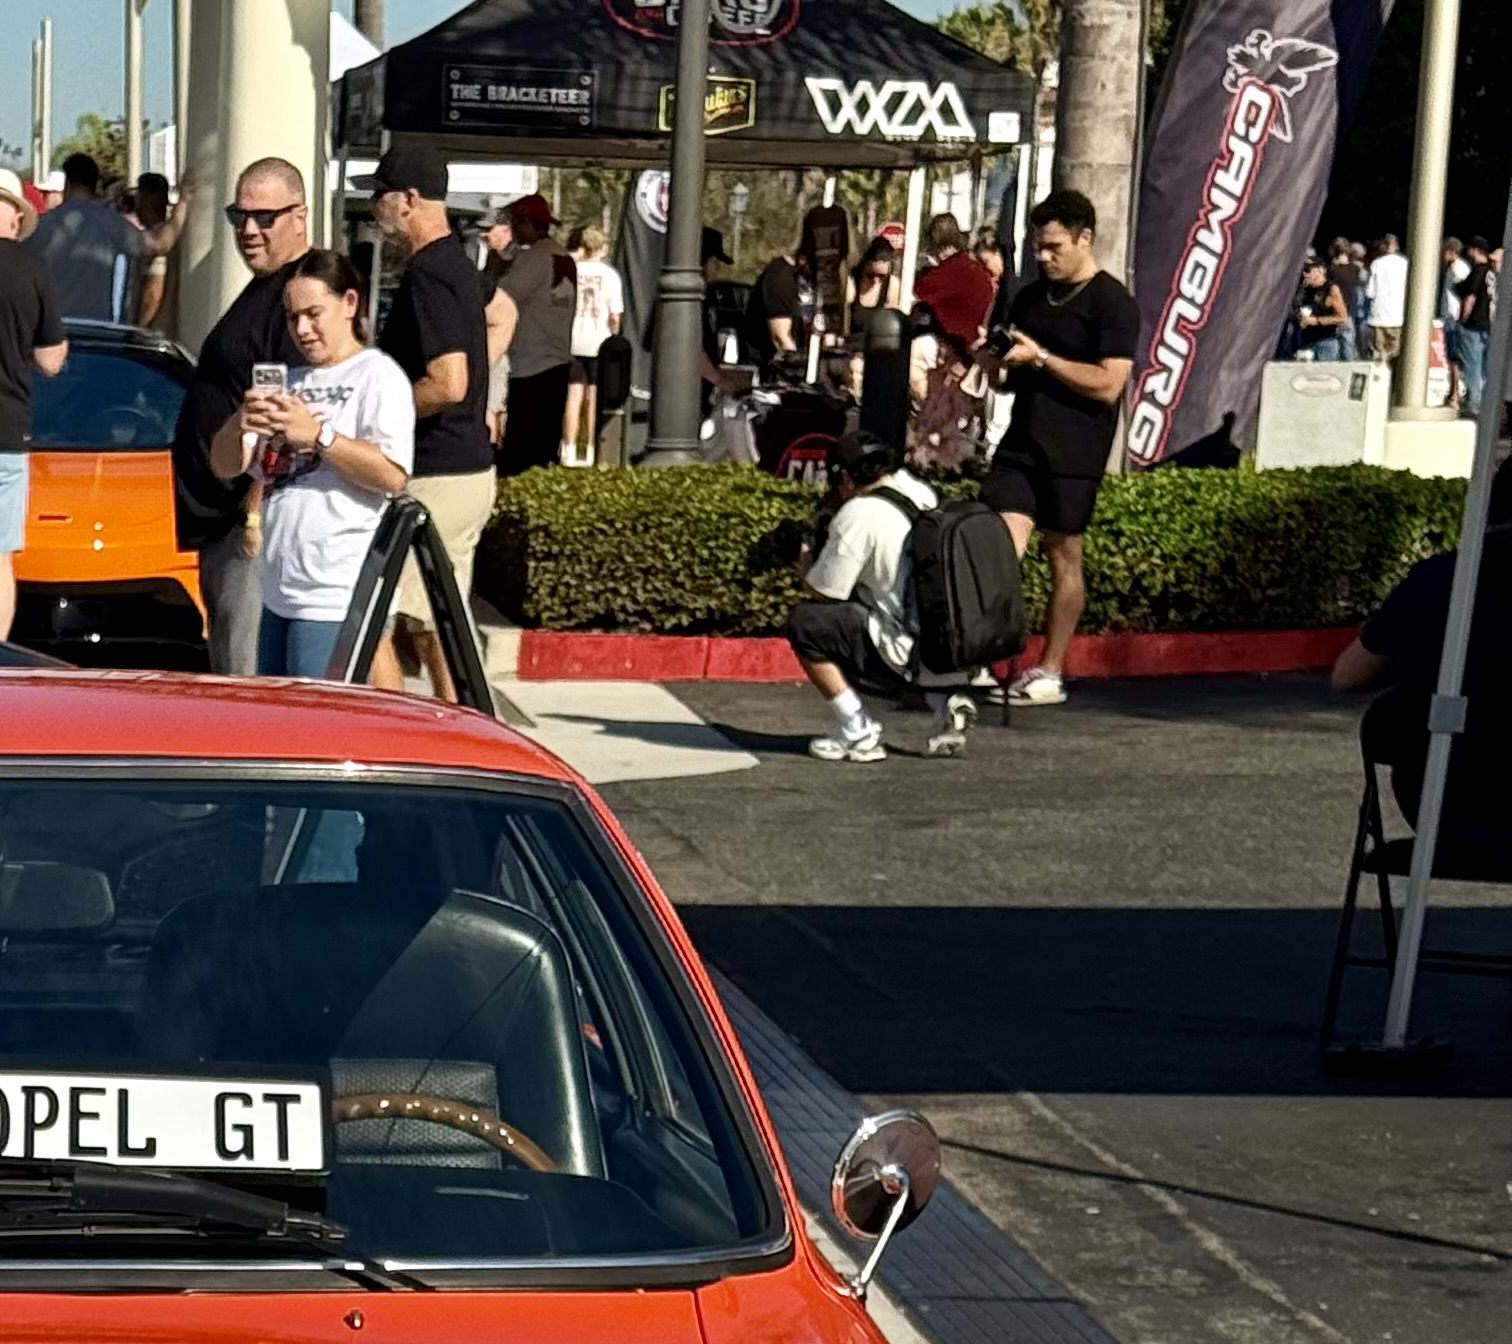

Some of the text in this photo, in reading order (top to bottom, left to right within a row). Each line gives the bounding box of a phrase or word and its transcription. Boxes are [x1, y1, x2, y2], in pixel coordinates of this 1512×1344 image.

[449, 83, 590, 105] THE BRACKETEER
[1128, 82, 1273, 460] CAMBURG
[214, 1091, 302, 1161] GT
